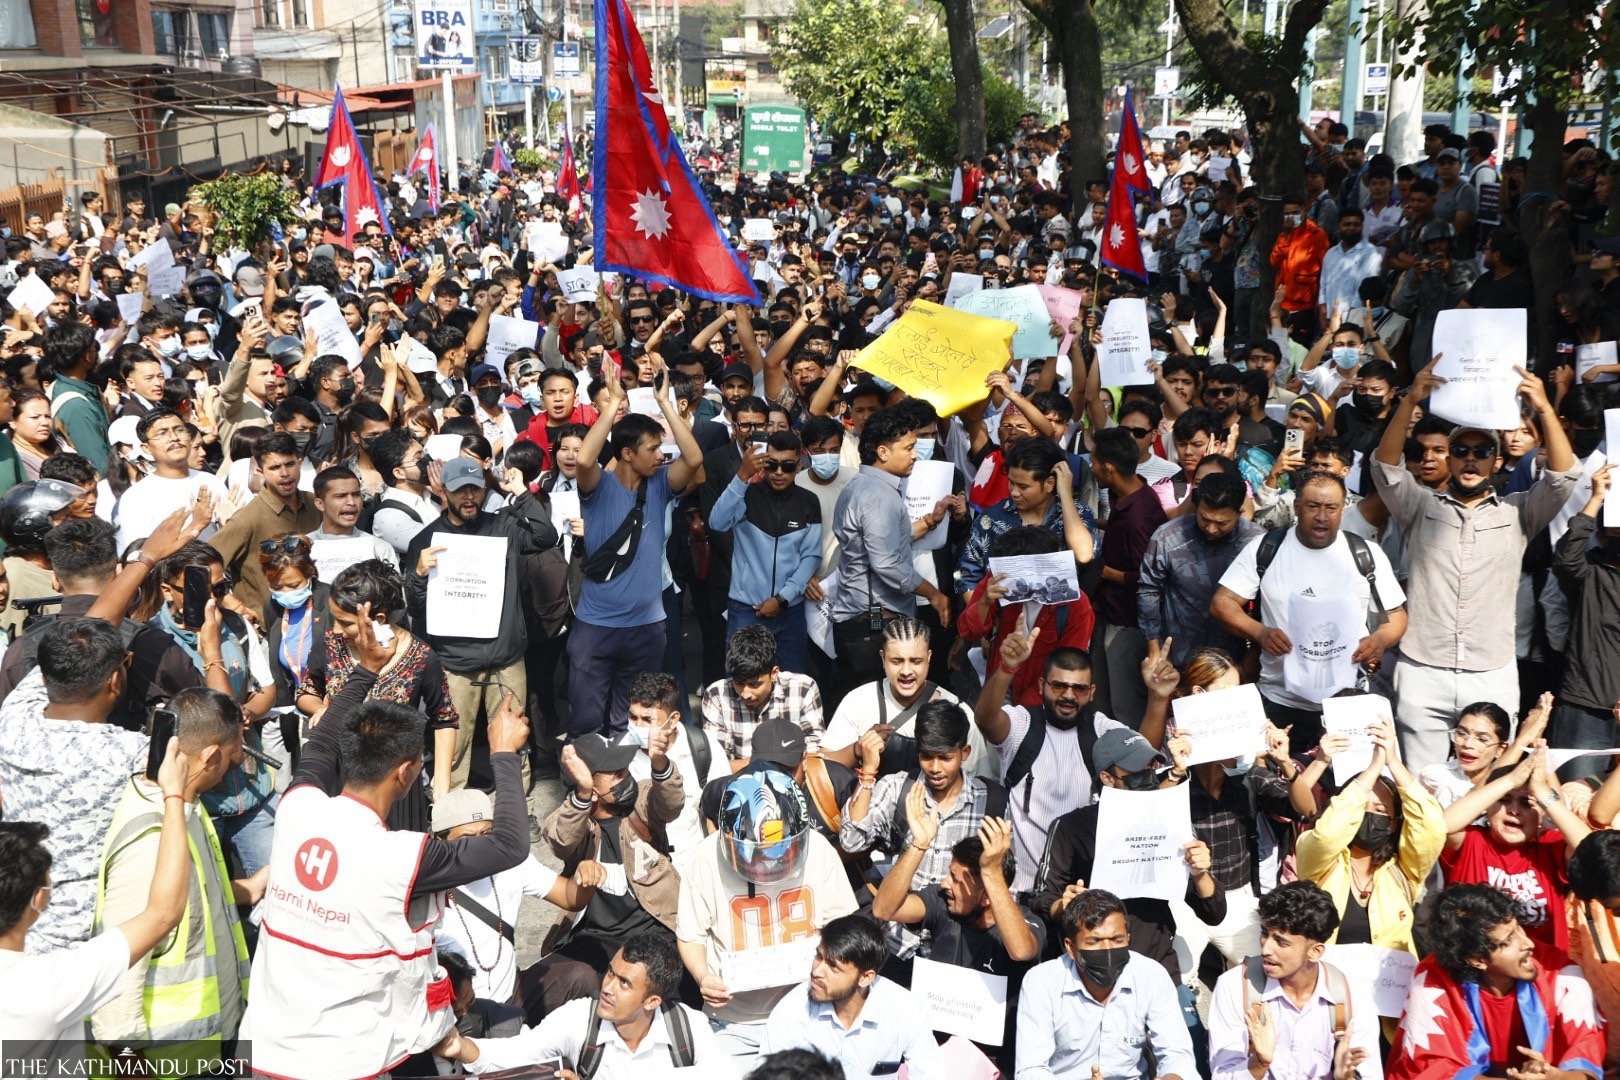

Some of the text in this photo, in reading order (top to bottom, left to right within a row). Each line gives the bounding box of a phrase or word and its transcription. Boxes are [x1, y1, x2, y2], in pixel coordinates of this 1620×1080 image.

[422, 10, 466, 26] BBA
[444, 590, 487, 598] INTEGRITY!
[1299, 644, 1347, 656] CORRUPTION
[1313, 640, 1334, 648] STOP
[630, 838, 660, 881] A
[270, 881, 350, 924] Hami Nepal
[927, 992, 982, 1012] Stop ghosting
